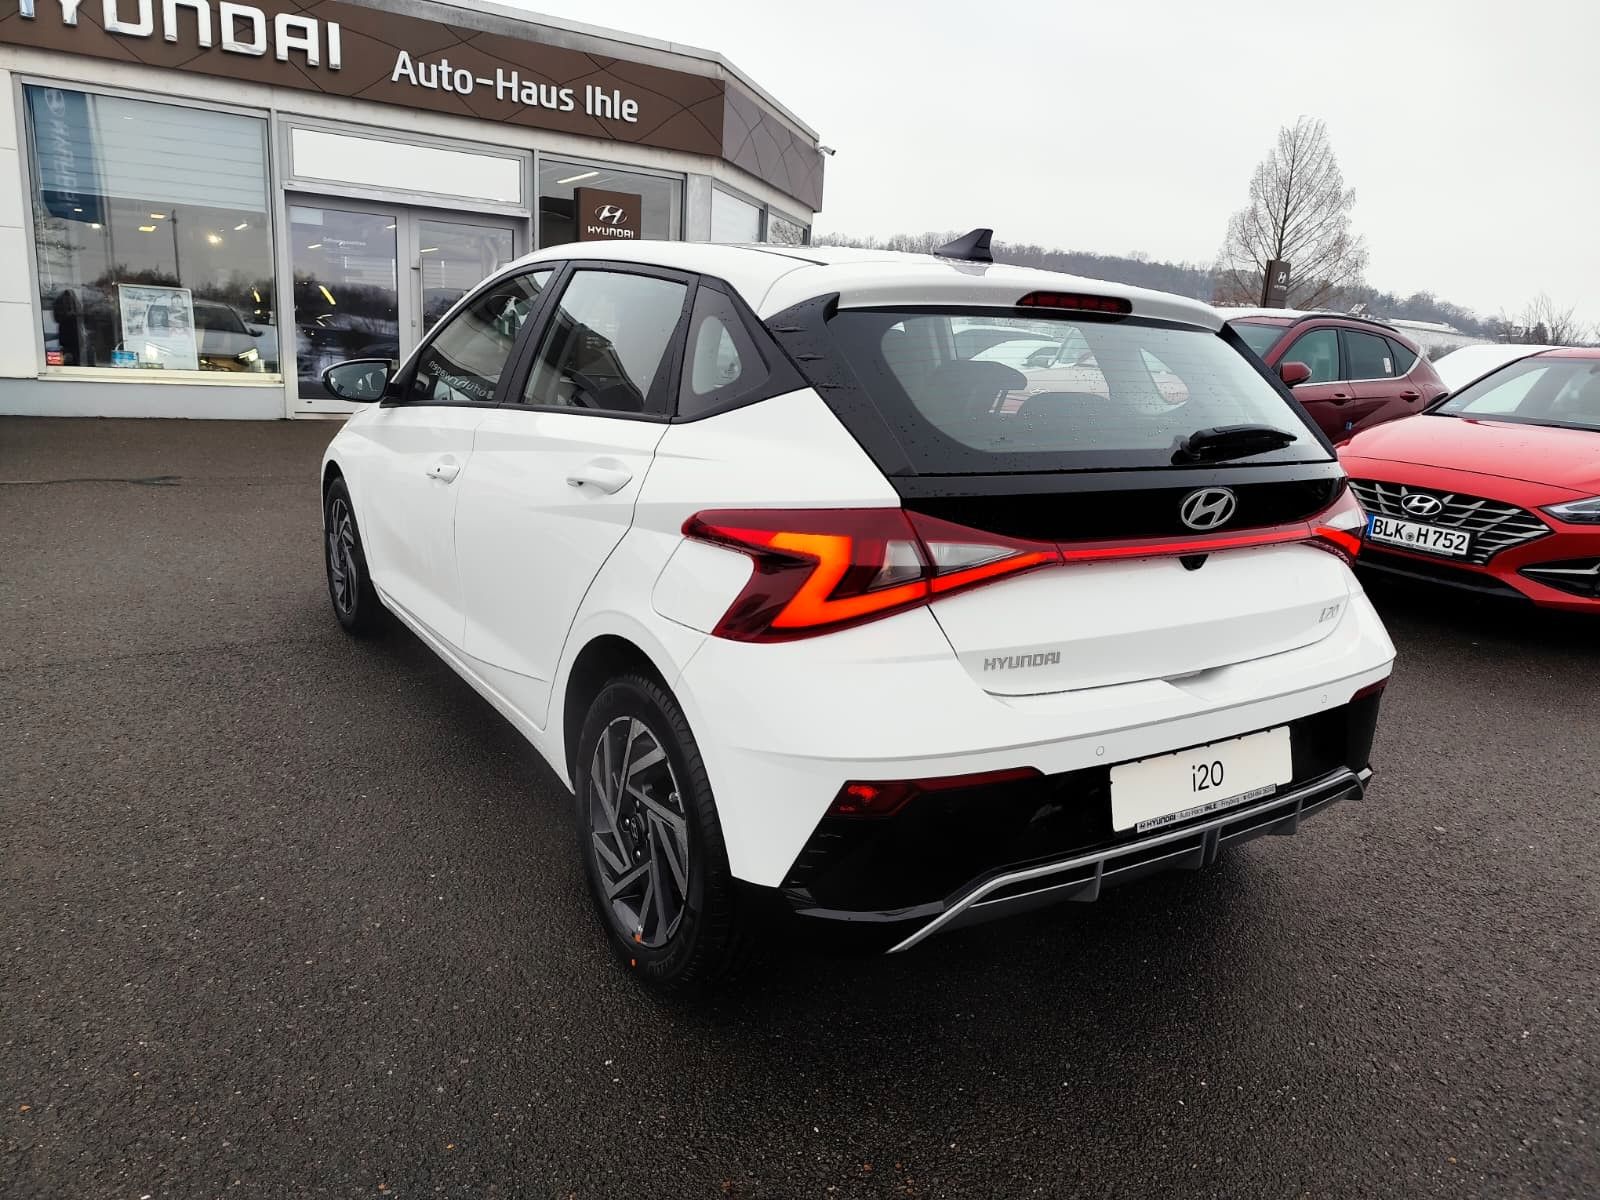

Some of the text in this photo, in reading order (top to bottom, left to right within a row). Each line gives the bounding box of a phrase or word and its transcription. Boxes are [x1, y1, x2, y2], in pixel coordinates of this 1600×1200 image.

[391, 50, 639, 123] Auto-Haus Ihle
[587, 225, 634, 239] HYUNDAI
[1373, 519, 1406, 540] BLK
[1415, 528, 1429, 545] H
[1432, 532, 1466, 551] 752
[983, 651, 1061, 672] HYUNDAI
[1191, 760, 1225, 792] i20
